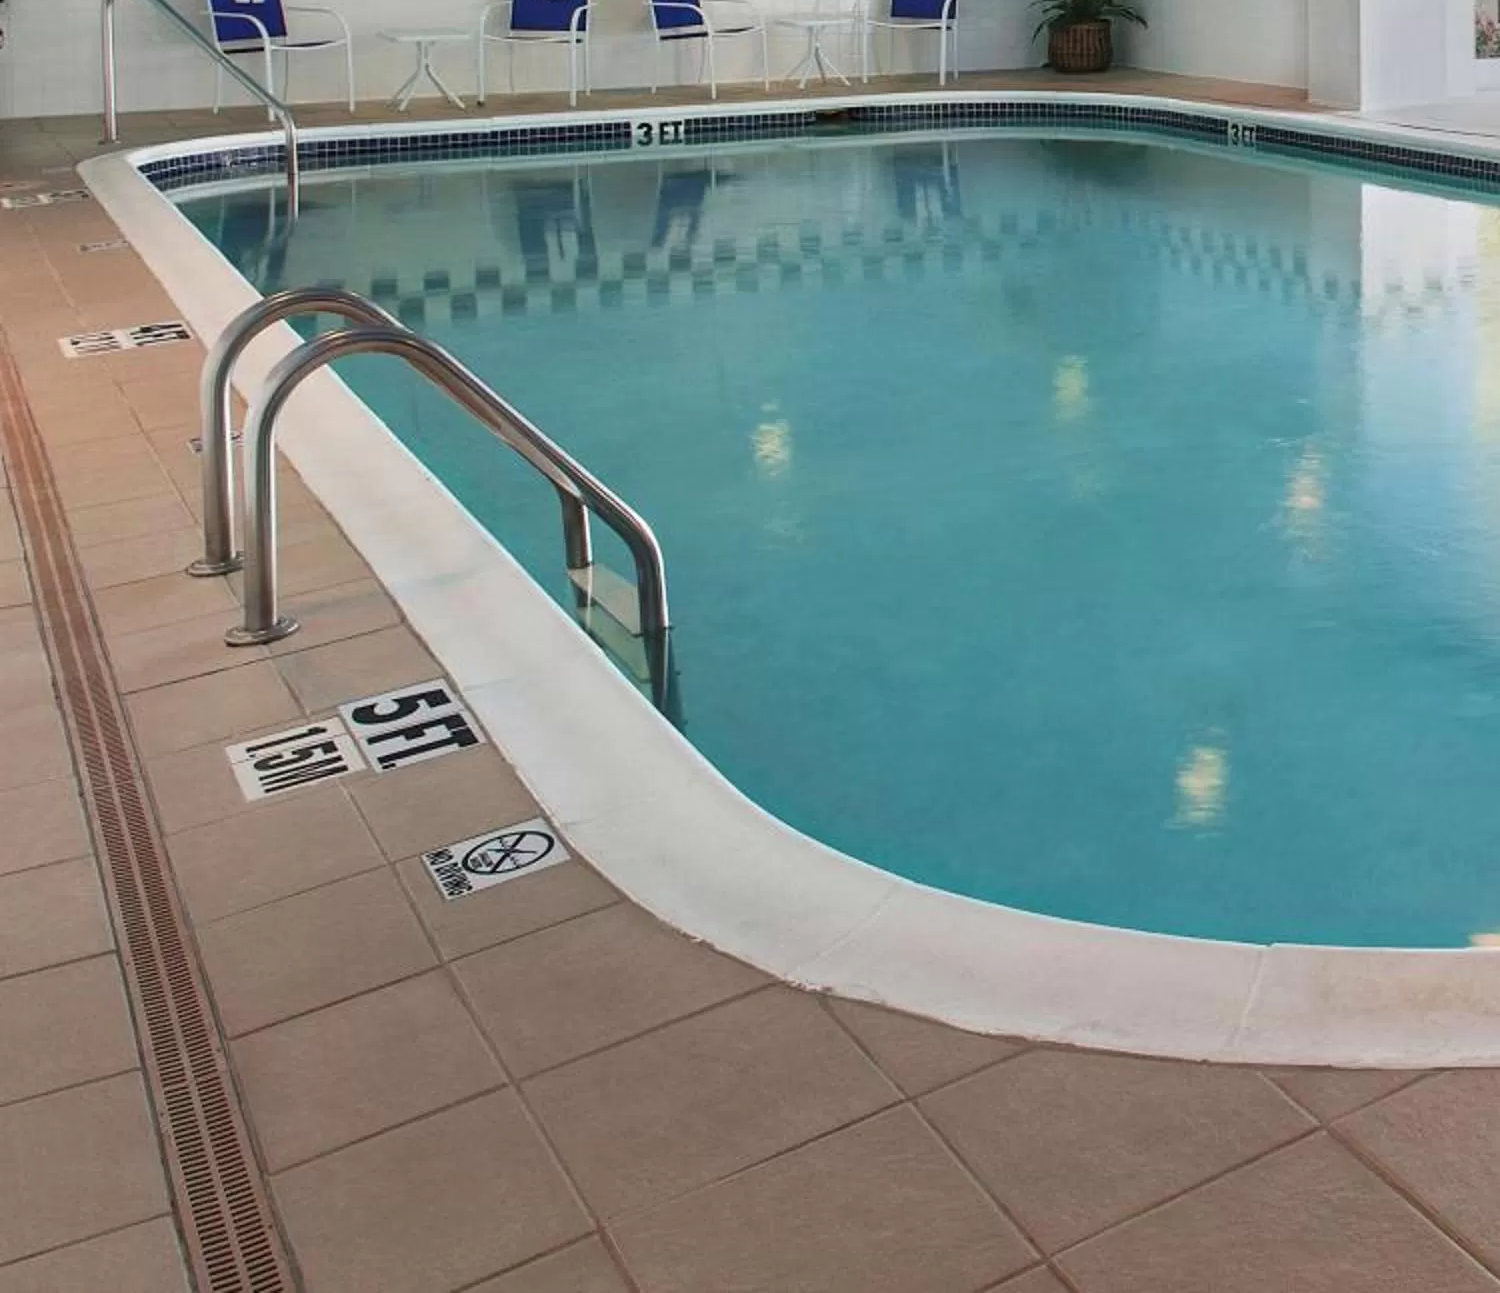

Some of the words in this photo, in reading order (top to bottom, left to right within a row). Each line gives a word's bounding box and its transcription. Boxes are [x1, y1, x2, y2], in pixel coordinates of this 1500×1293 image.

[636, 122, 653, 145] 3
[352, 688, 452, 725] 5
[424, 848, 454, 867] NO
[434, 861, 473, 896] DIVING
